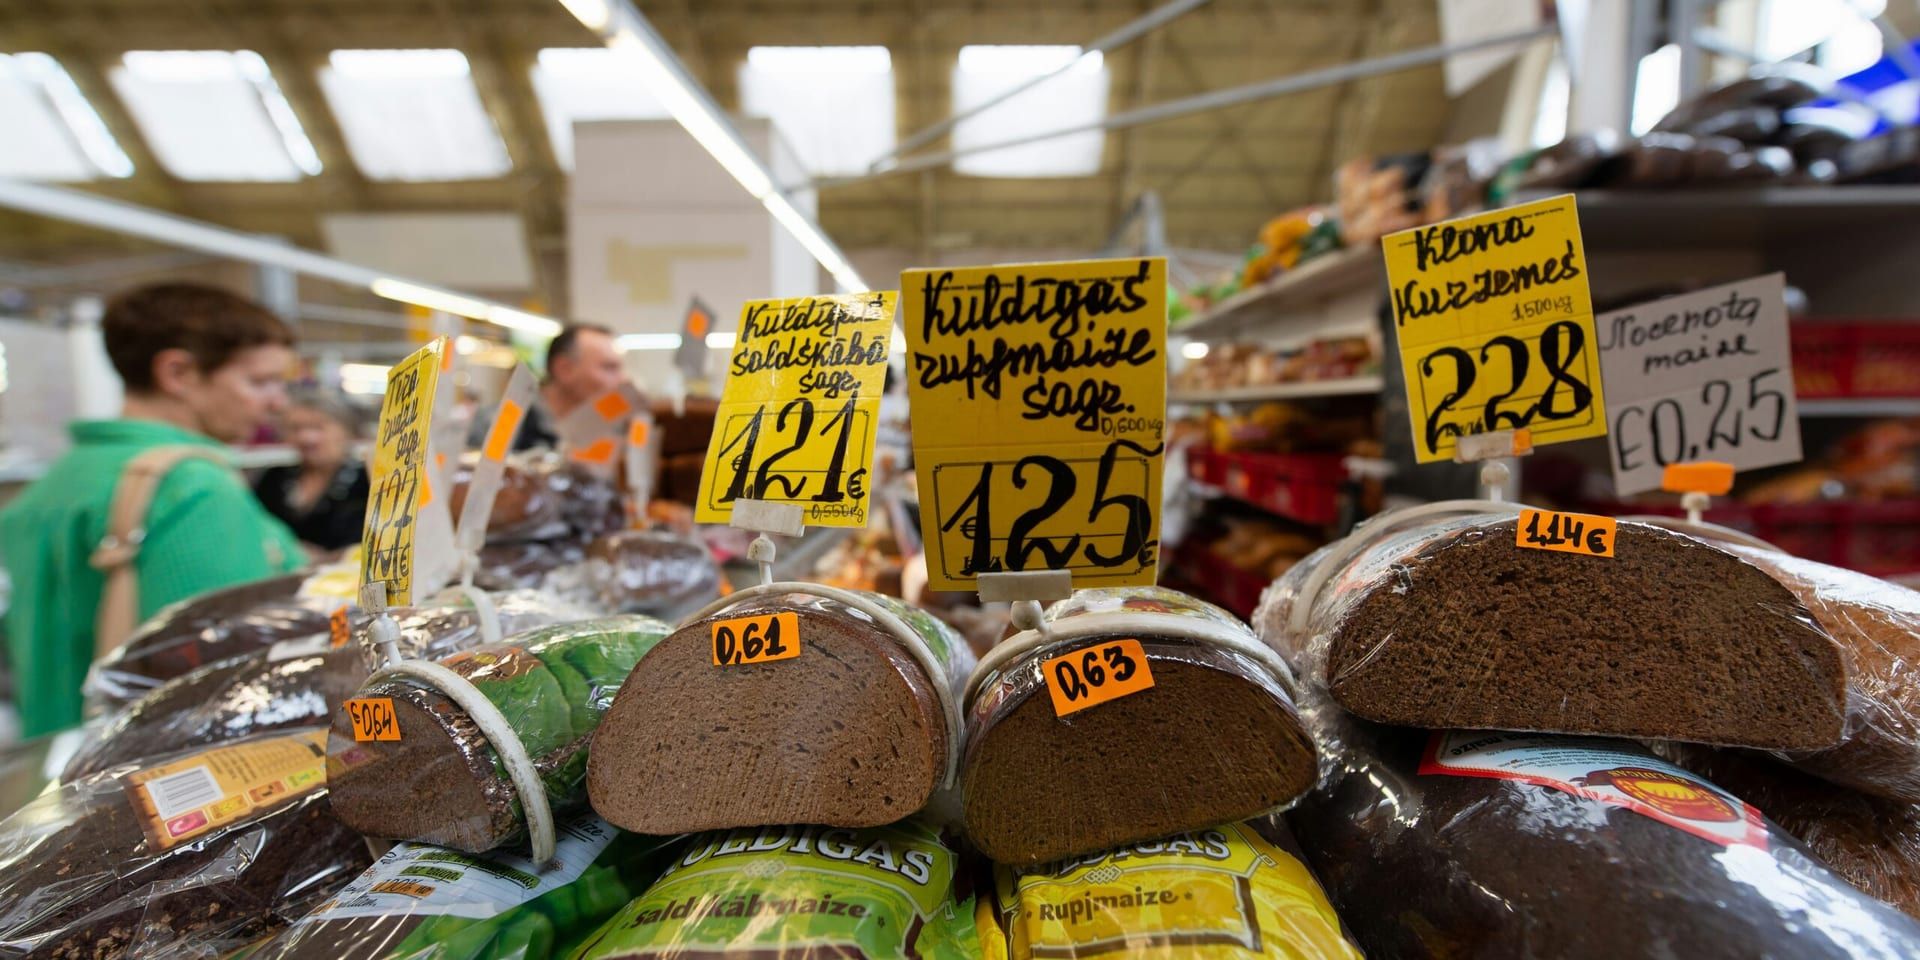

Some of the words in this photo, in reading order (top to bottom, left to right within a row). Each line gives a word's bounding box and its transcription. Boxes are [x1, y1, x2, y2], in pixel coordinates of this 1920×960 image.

[1415, 216, 1534, 271] Klona
[1423, 321, 1593, 454] 228
[716, 617, 787, 666] 0,61
[1055, 646, 1136, 701] 0,63
[1040, 886, 1179, 925] Rupjmaize
